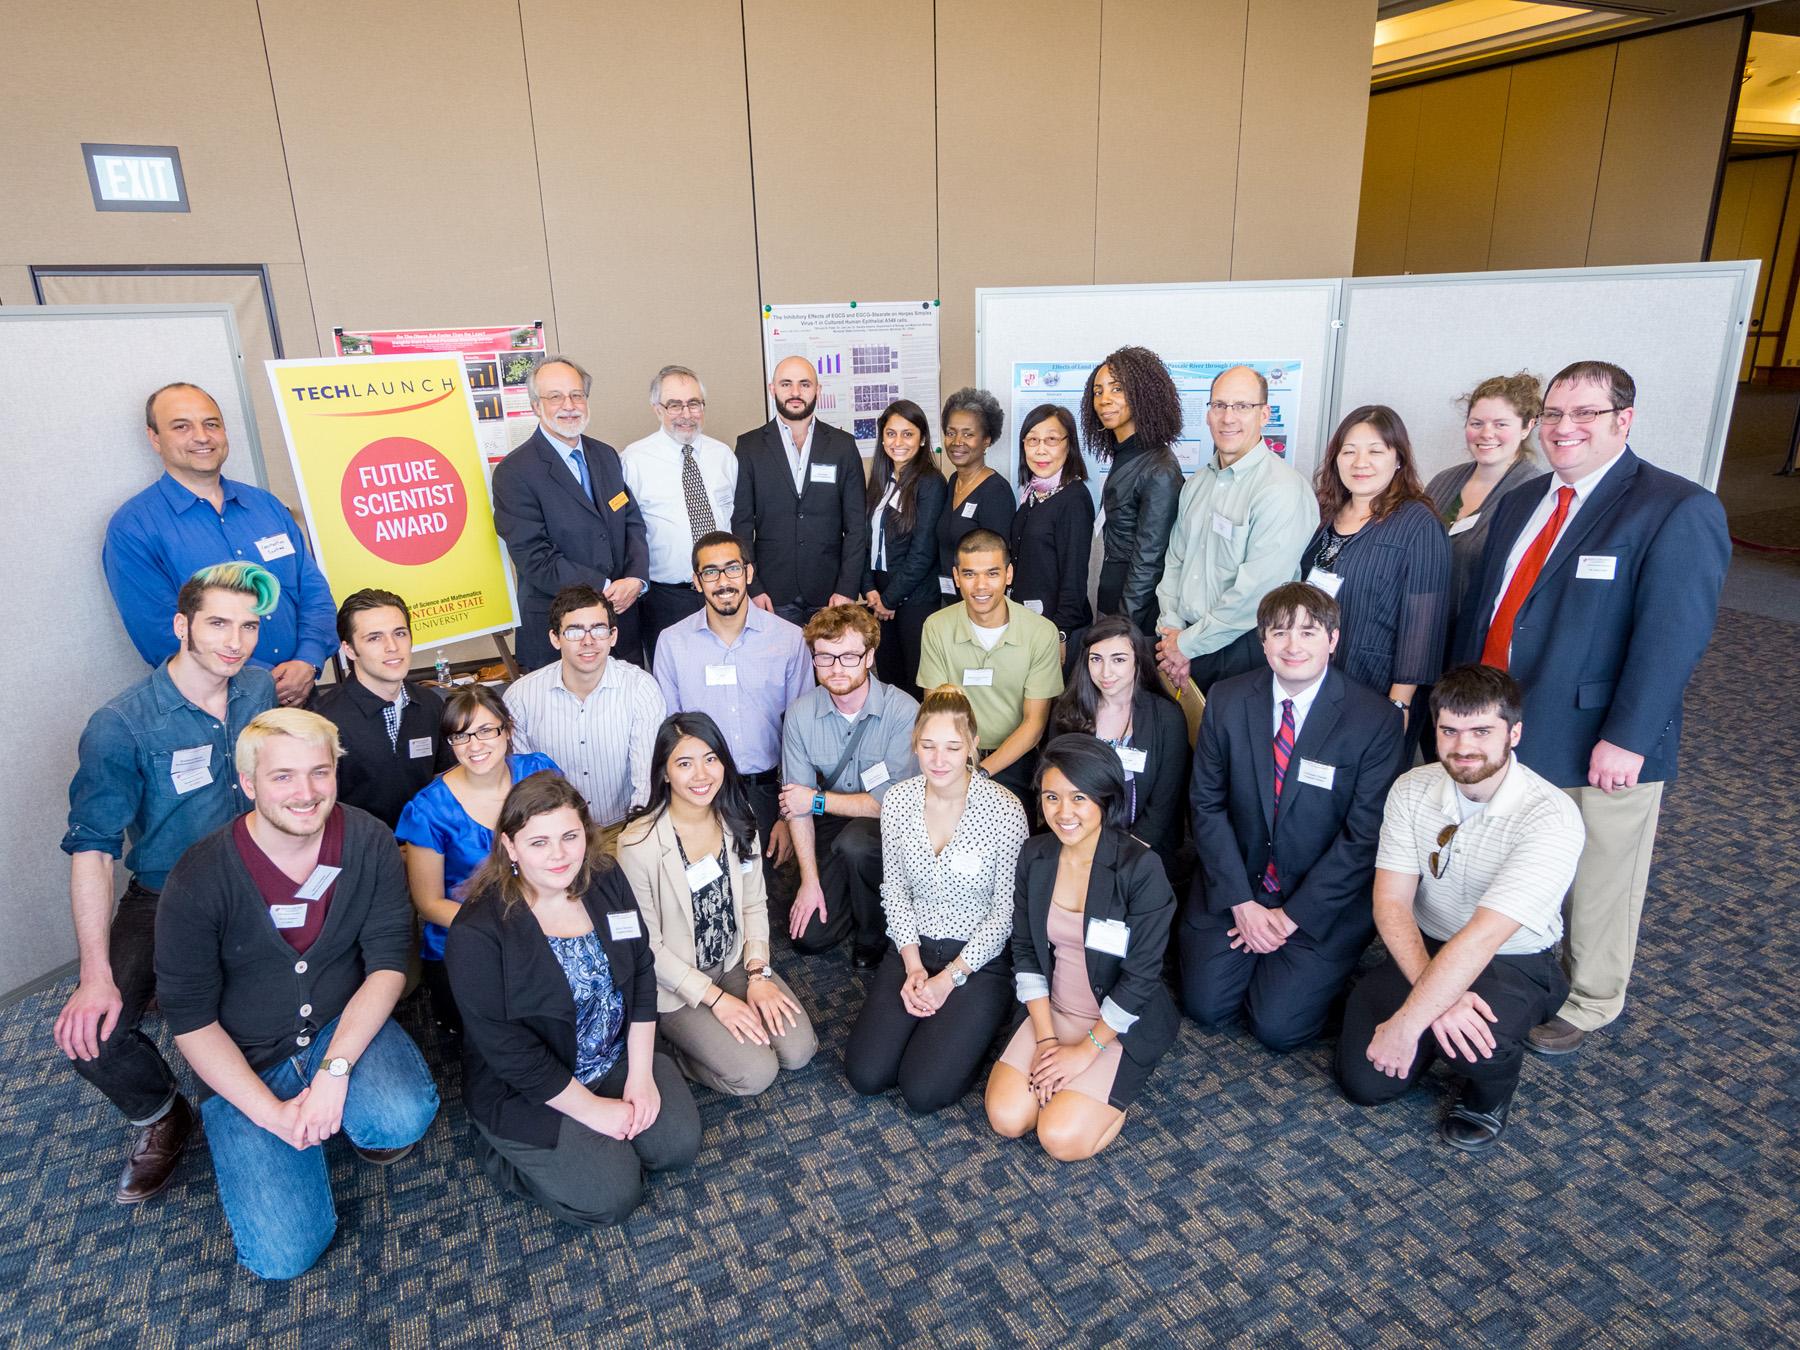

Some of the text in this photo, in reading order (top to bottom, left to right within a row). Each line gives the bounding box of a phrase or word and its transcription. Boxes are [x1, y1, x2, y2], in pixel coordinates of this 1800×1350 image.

[105, 159, 168, 199] EXIT
[359, 459, 439, 488] FUTURE
[353, 483, 454, 517] SCIENTIST
[375, 512, 448, 542] AWARD
[411, 596, 485, 619] NTCLAIR STATE
[419, 599, 440, 608] Science
[441, 595, 451, 603] and
[451, 590, 482, 601] Mathematics
[414, 612, 469, 631] UNIVERSITY
